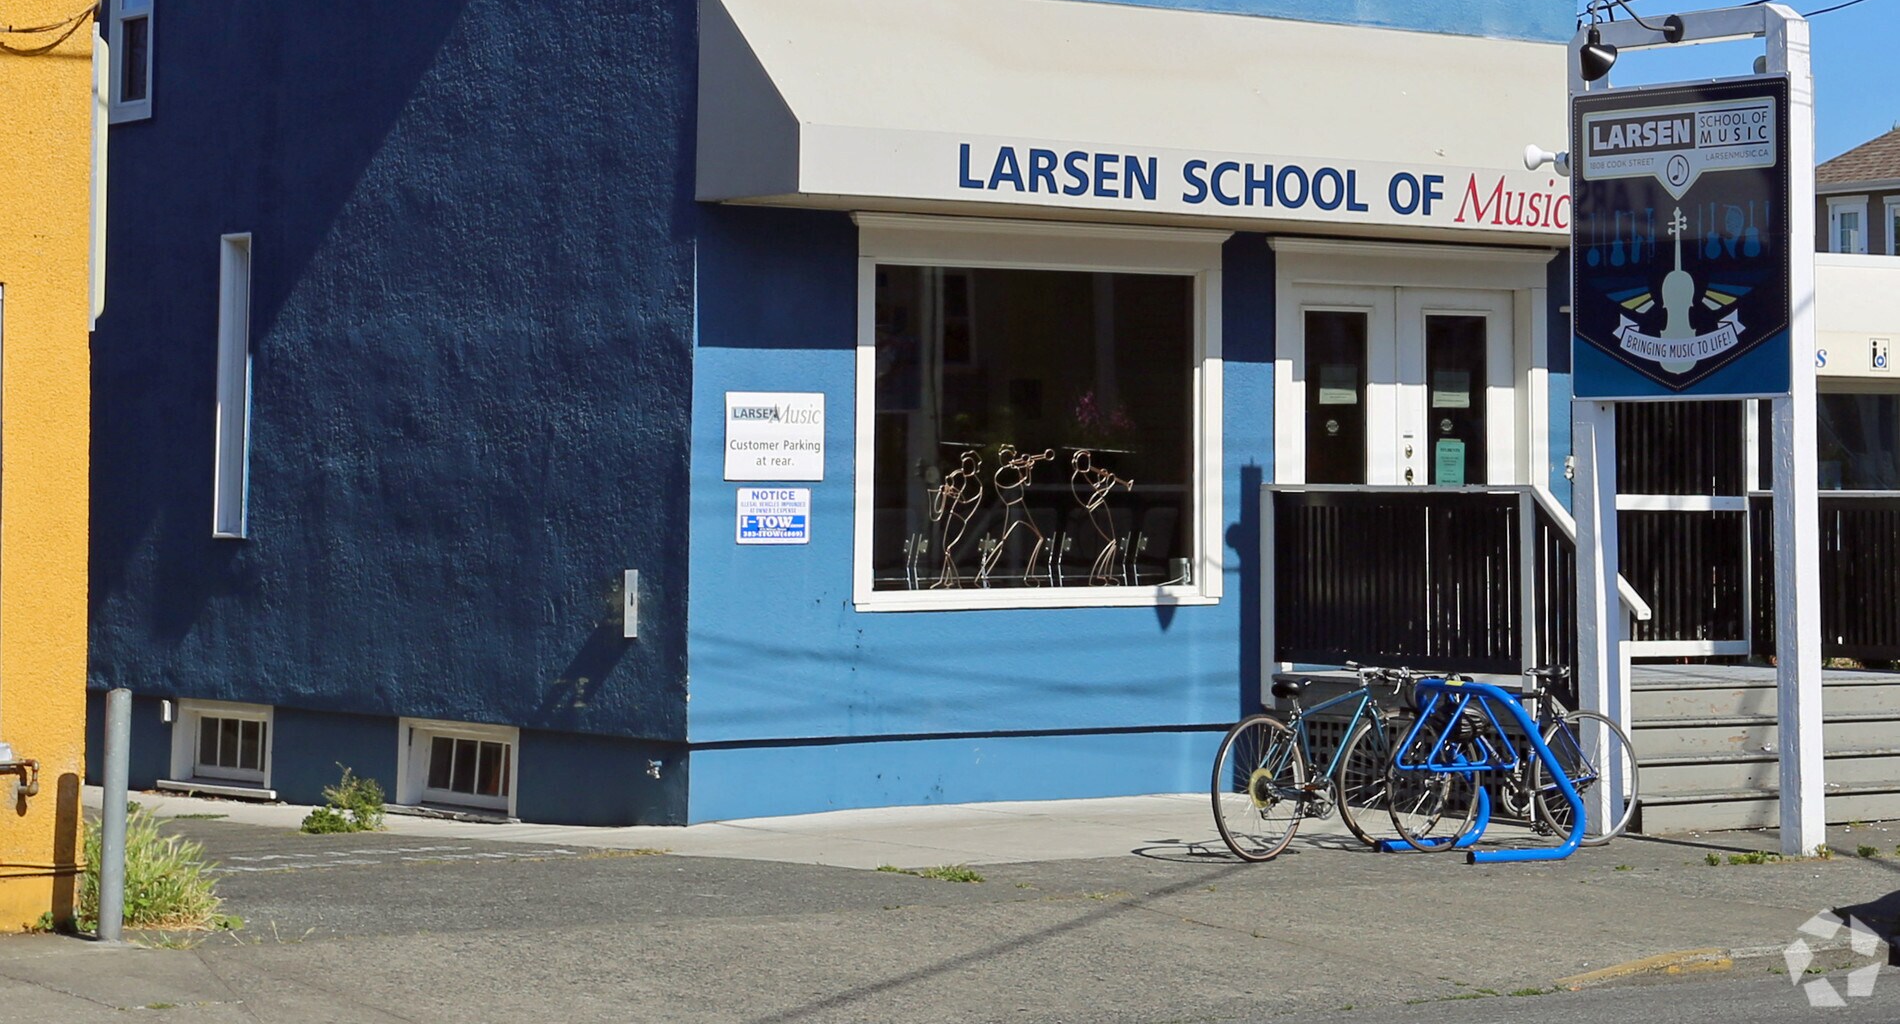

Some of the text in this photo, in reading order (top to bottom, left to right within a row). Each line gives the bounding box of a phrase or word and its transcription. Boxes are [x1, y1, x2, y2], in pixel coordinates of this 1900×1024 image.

[1700, 111, 1768, 128] SCHOOL OF
[1593, 119, 1691, 151] LARSEN
[1700, 125, 1767, 145] MUSIC
[1606, 160, 1627, 169] COOK
[1627, 158, 1654, 167] STREET
[1705, 149, 1768, 161] LARSENMUSIC.CA
[959, 144, 1158, 201] LARSEN
[1182, 160, 1369, 213] SCHOOL
[1388, 172, 1444, 216] OF
[1454, 173, 1570, 230] Music
[1626, 331, 1732, 358] BRINGING MUSIC TO LIFE!
[733, 403, 821, 425] LARSEN Music
[730, 439, 821, 453] Customer Parking
[756, 456, 795, 466] at rear.
[752, 490, 796, 501] NOTICE
